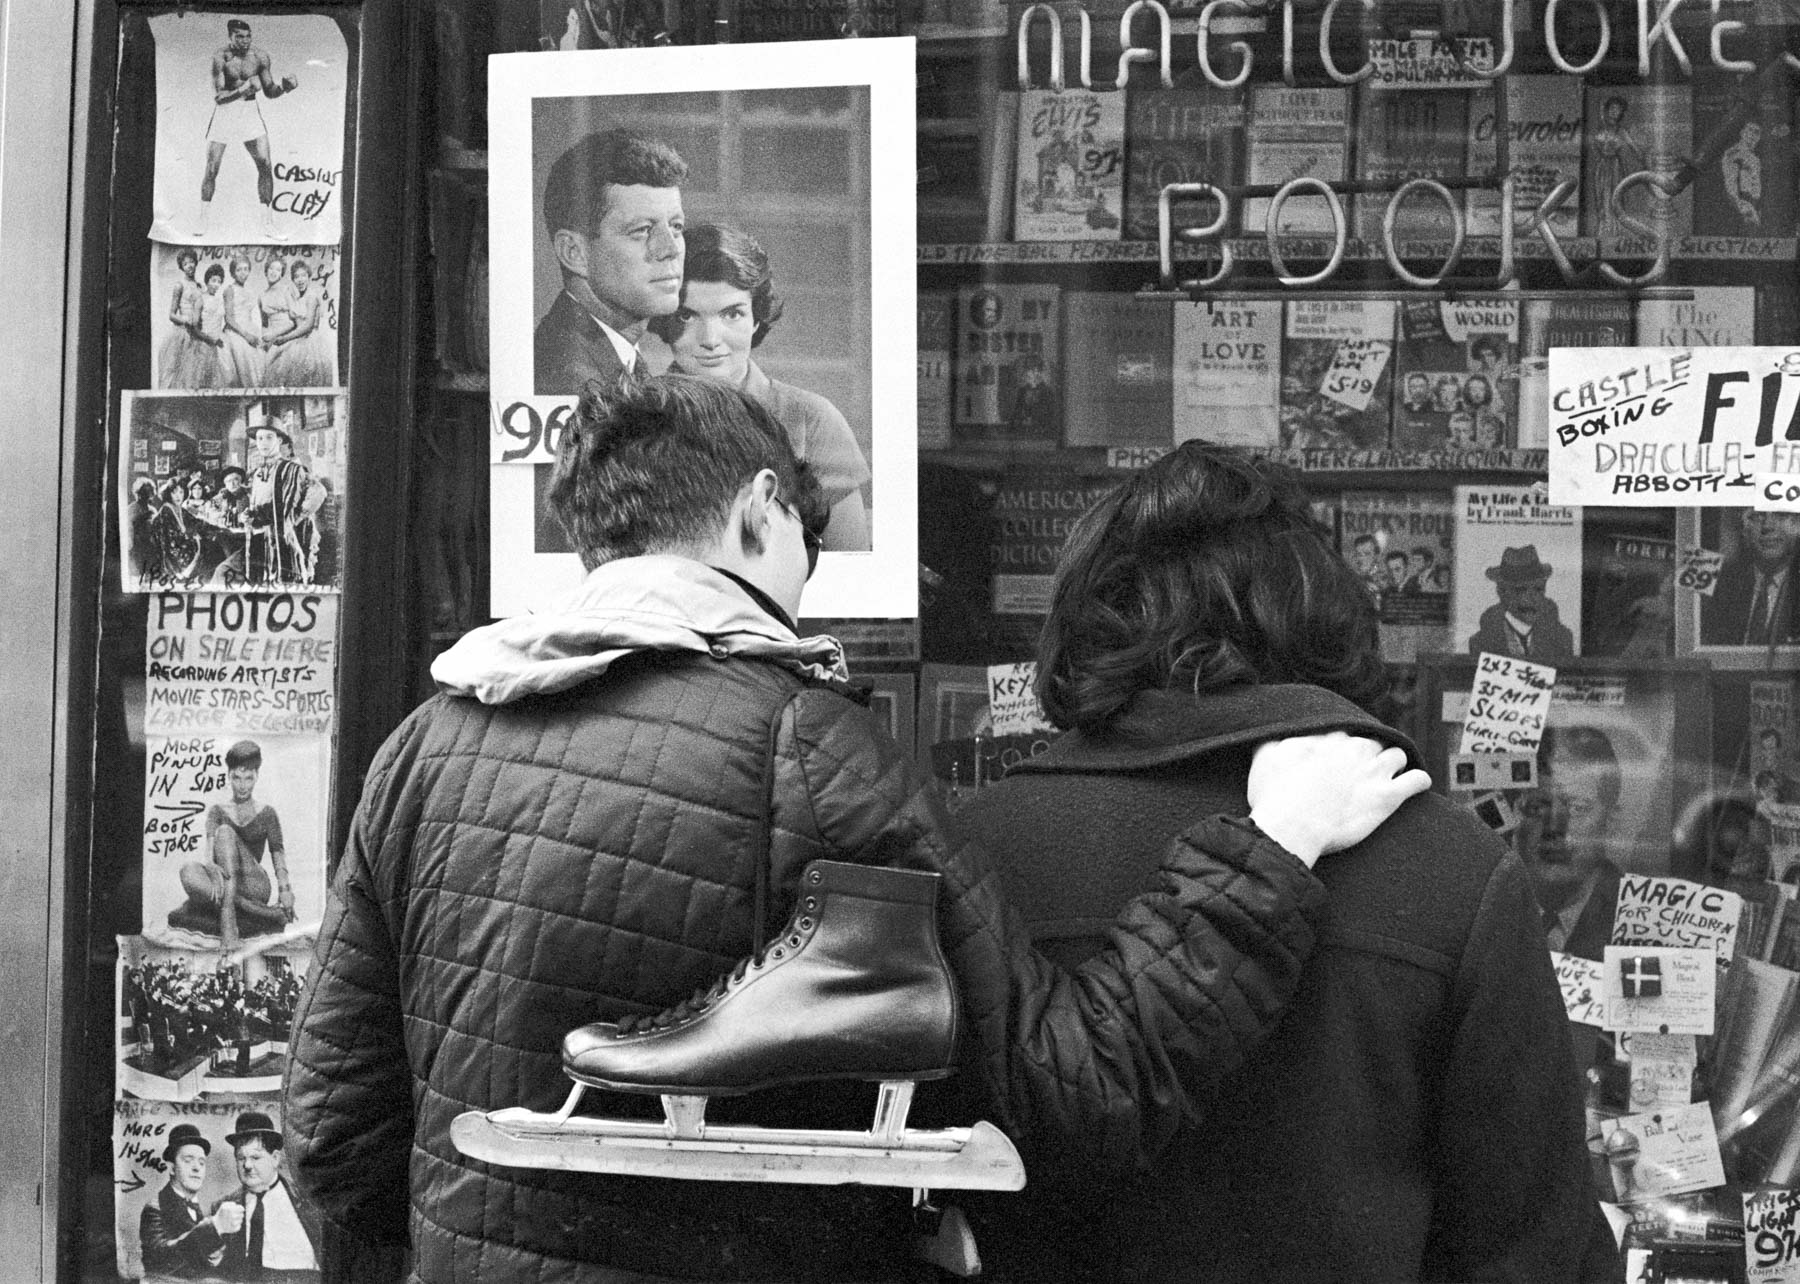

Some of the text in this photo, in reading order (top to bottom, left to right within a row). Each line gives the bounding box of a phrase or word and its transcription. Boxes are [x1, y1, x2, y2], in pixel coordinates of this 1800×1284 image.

[1018, 0, 1800, 92] MAGIC JOKE
[1032, 102, 1103, 138] ELVIS
[271, 190, 331, 220] CLAY
[1159, 164, 1694, 287] BOOKS
[1211, 310, 1257, 328] ART
[1455, 310, 1516, 327] WORLD
[1201, 342, 1266, 361] LOVE
[1553, 352, 1692, 412] CASTLE
[1556, 397, 1674, 447] BOXING
[1428, 446, 1513, 469] SELECTION
[1612, 474, 1725, 495] ABBOTT
[1468, 492, 1488, 507] My
[1492, 492, 1517, 505] Life
[1467, 506, 1573, 520] by Frank Harris
[157, 589, 322, 633] PHOTOS
[150, 634, 332, 663] ON SALE HERE
[231, 664, 316, 690] ARTISTS
[150, 687, 202, 707] MOVIE
[149, 706, 226, 726] LARGE
[1469, 697, 1544, 730] SLIDES
[163, 738, 215, 754] MORE
[149, 774, 178, 797] IN
[145, 819, 194, 834] BOOK
[147, 834, 202, 857] STORE
[1620, 879, 1725, 913] MAGIC
[1616, 903, 1735, 935] FOR CHILDREN
[122, 1121, 168, 1137] MORE
[118, 1141, 141, 1159] IN
